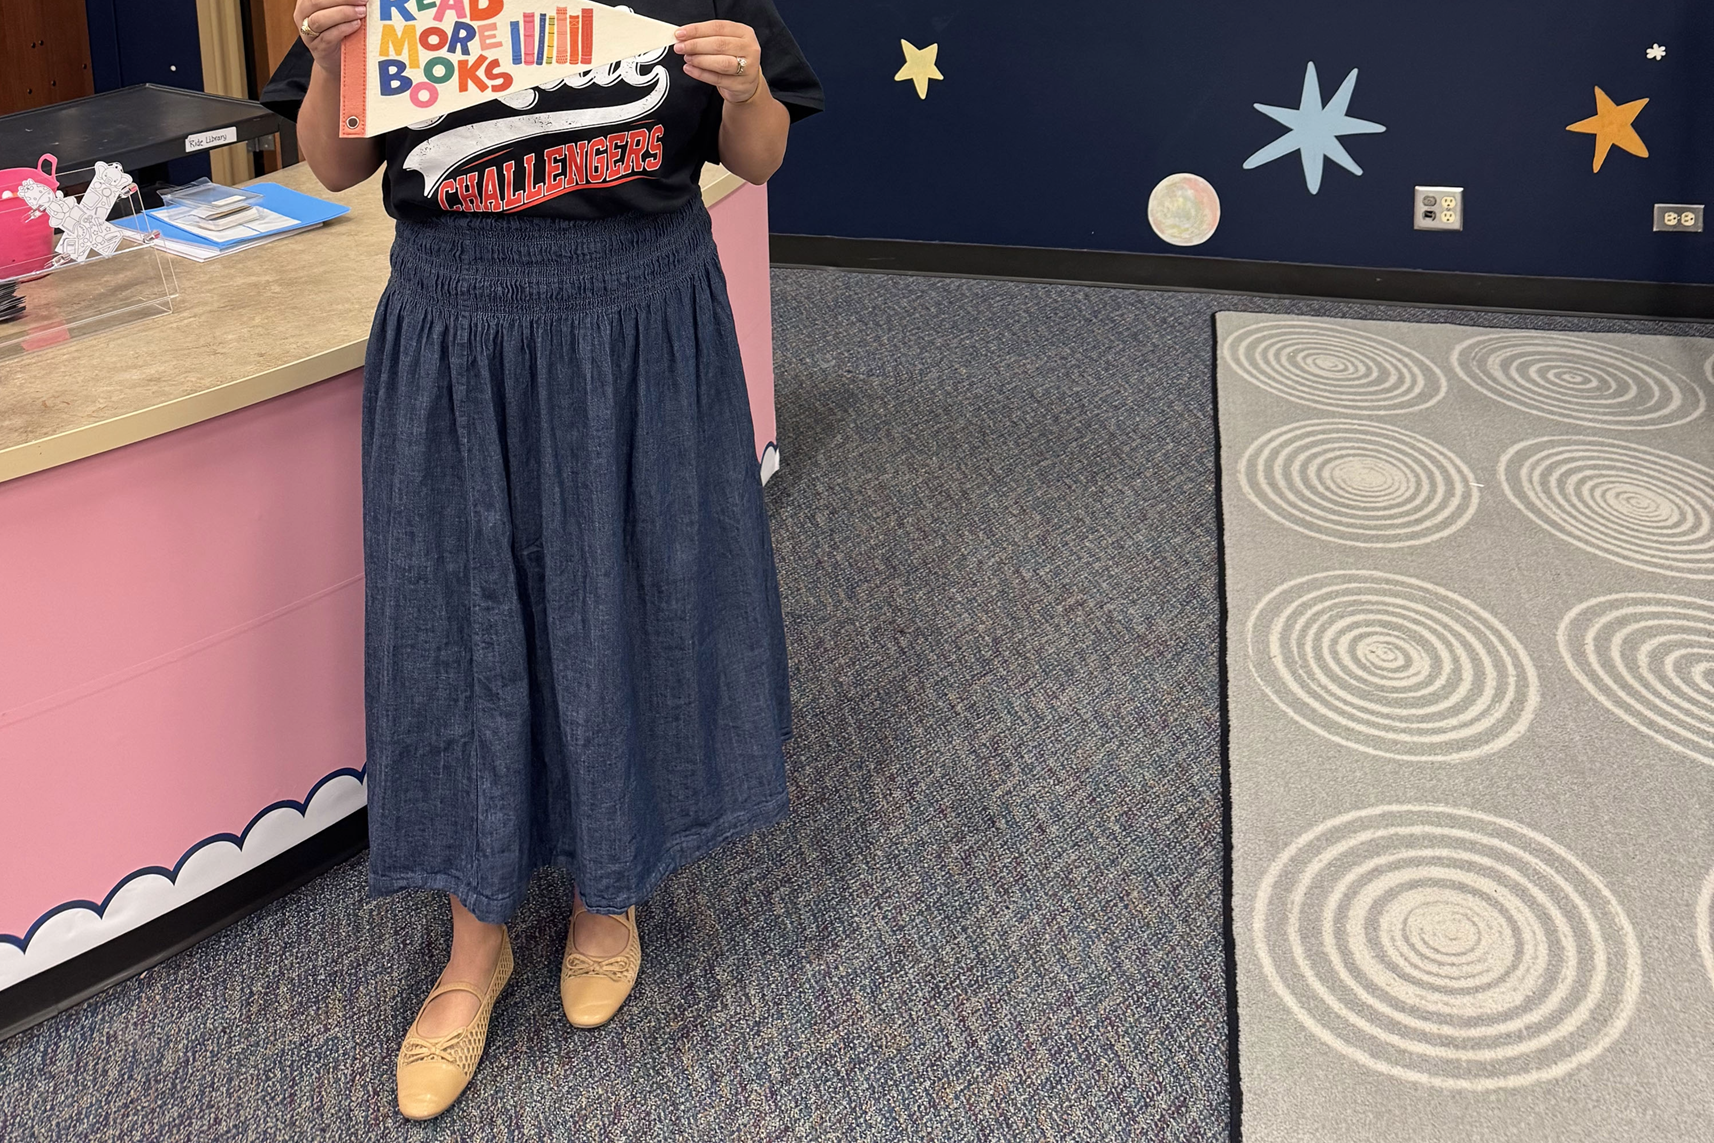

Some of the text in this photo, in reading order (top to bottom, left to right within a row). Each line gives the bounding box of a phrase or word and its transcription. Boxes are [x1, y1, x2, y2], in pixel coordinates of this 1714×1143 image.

[378, 20, 502, 70] MORE
[378, 54, 514, 108] BOOKS
[188, 134, 227, 148] Ride Library
[438, 124, 664, 214] CHALLENGERS
